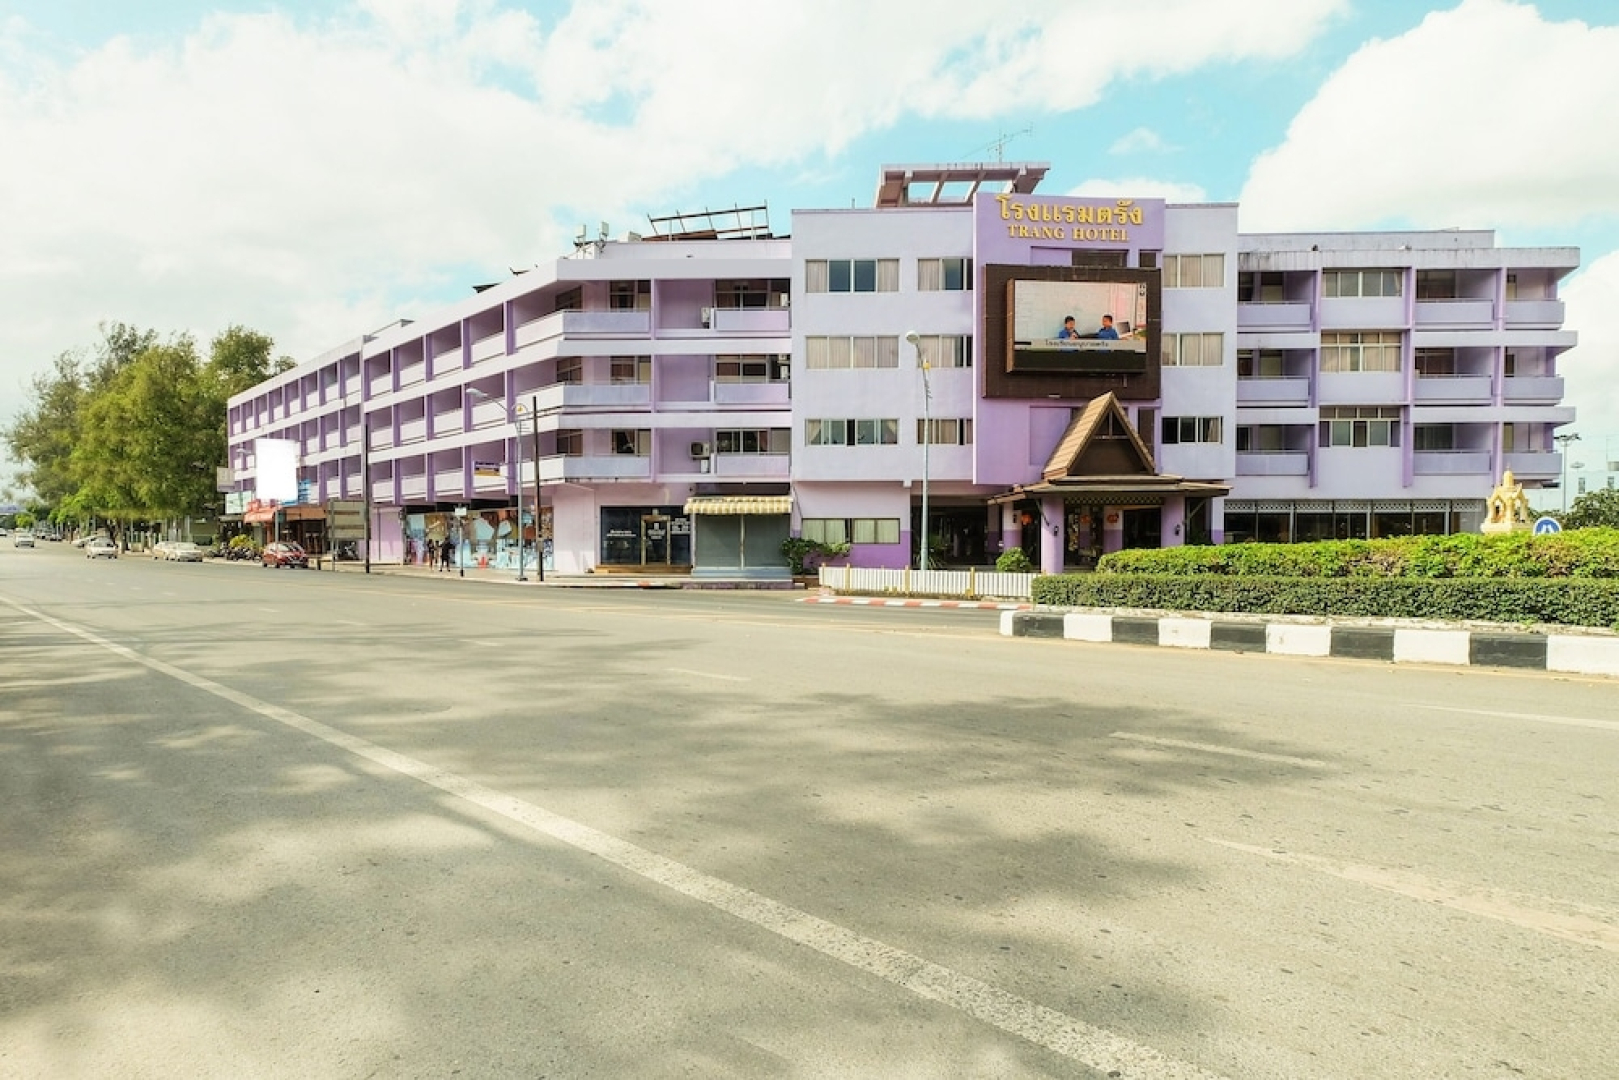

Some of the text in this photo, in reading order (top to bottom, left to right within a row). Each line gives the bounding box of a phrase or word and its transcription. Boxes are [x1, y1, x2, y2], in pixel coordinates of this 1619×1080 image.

[996, 193, 1144, 225] โรงแรมตรัง
[1008, 224, 1130, 242] TRANG HOTEL
